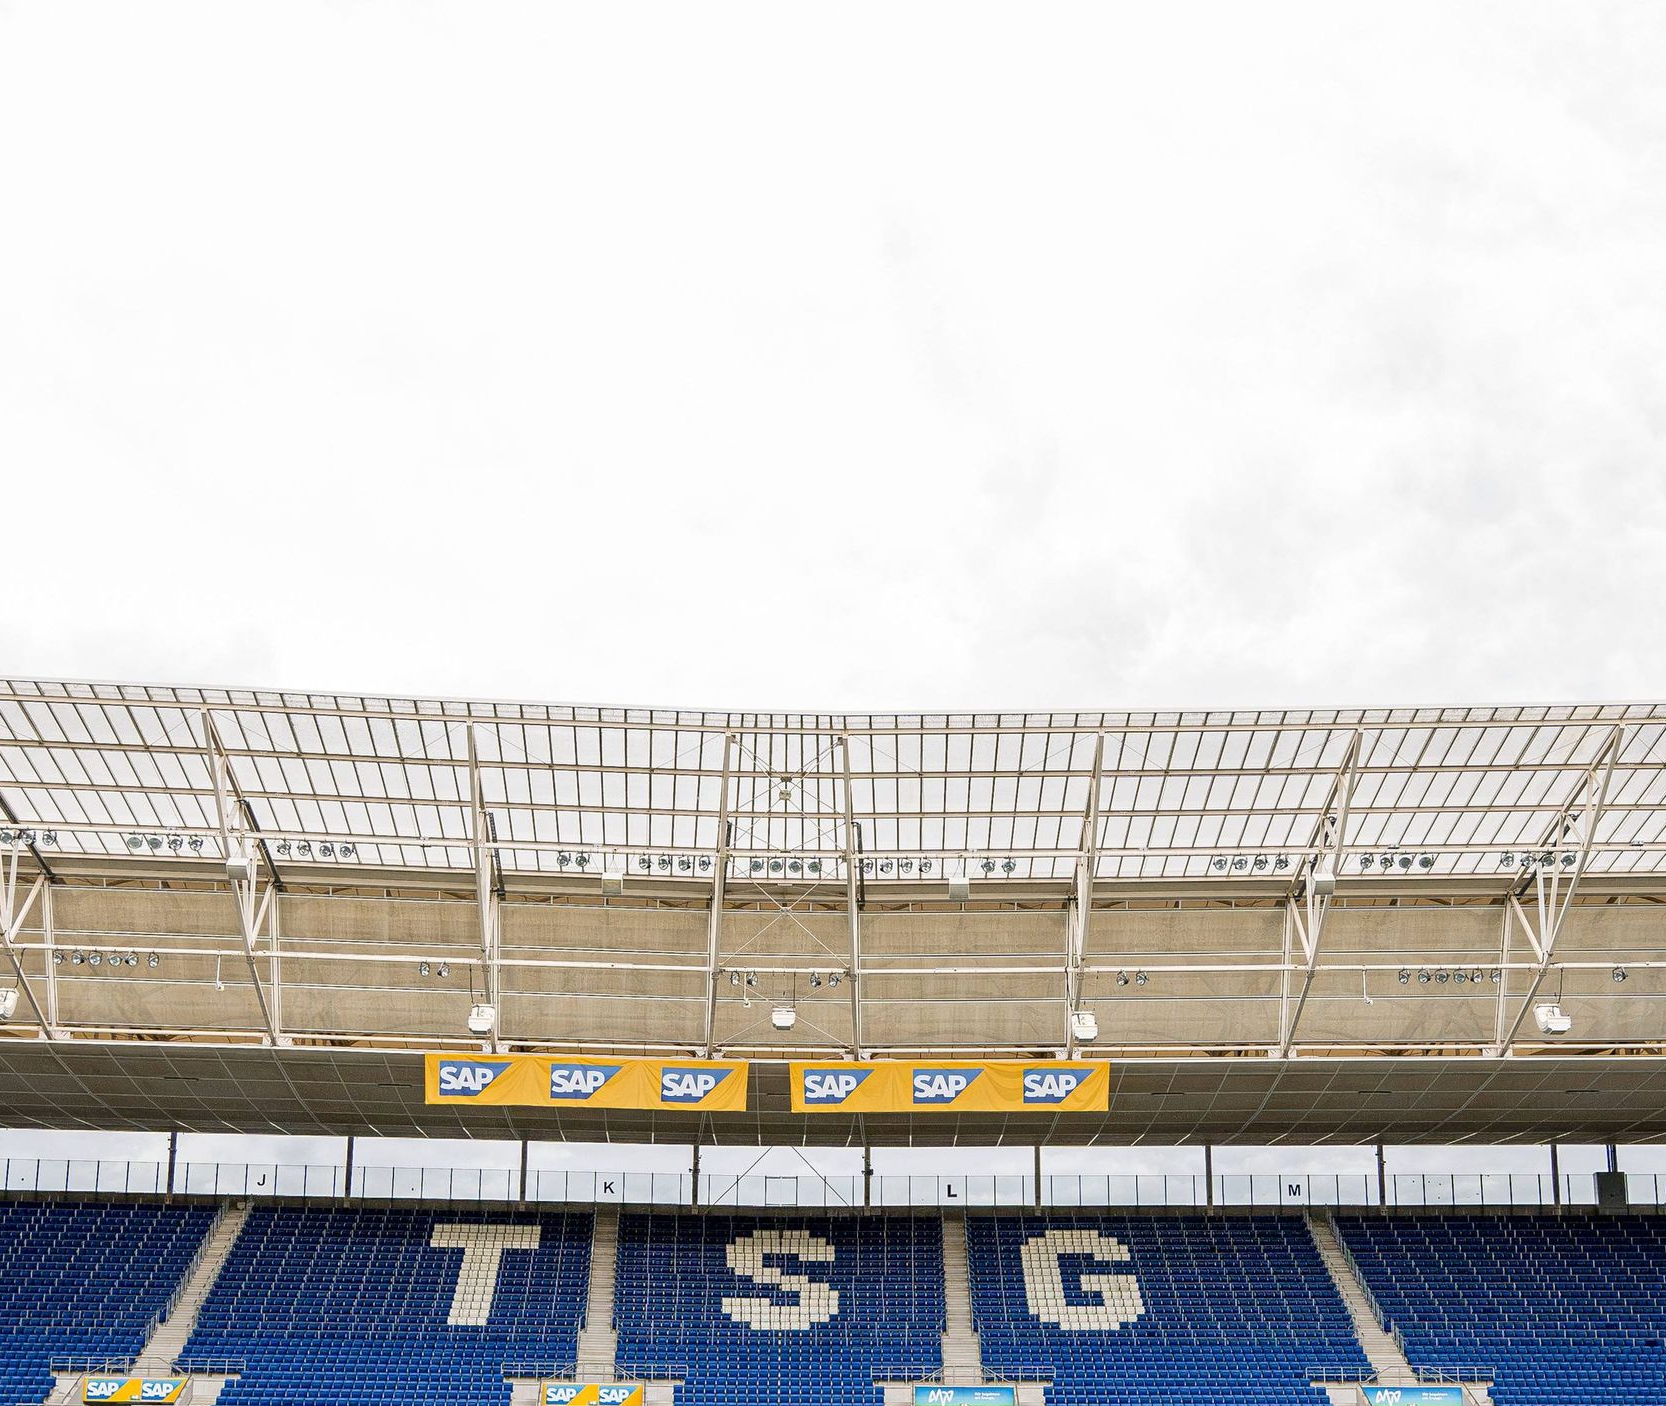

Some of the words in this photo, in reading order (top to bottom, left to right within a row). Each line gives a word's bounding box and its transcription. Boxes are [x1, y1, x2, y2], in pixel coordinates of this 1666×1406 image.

[439, 1066, 494, 1091] SAP
[551, 1069, 605, 1094] SAP
[662, 1072, 716, 1097] SAP
[804, 1073, 857, 1098] SAP
[914, 1073, 967, 1098] SAP
[1024, 1073, 1077, 1097] SAP
[257, 1174, 266, 1186] J
[604, 1181, 615, 1194] K
[947, 1184, 957, 1197] L
[1288, 1184, 1301, 1196] M
[86, 1381, 119, 1397] SAP
[142, 1382, 174, 1397] SAP
[546, 1388, 577, 1402] SAP
[599, 1389, 629, 1403] SAP
